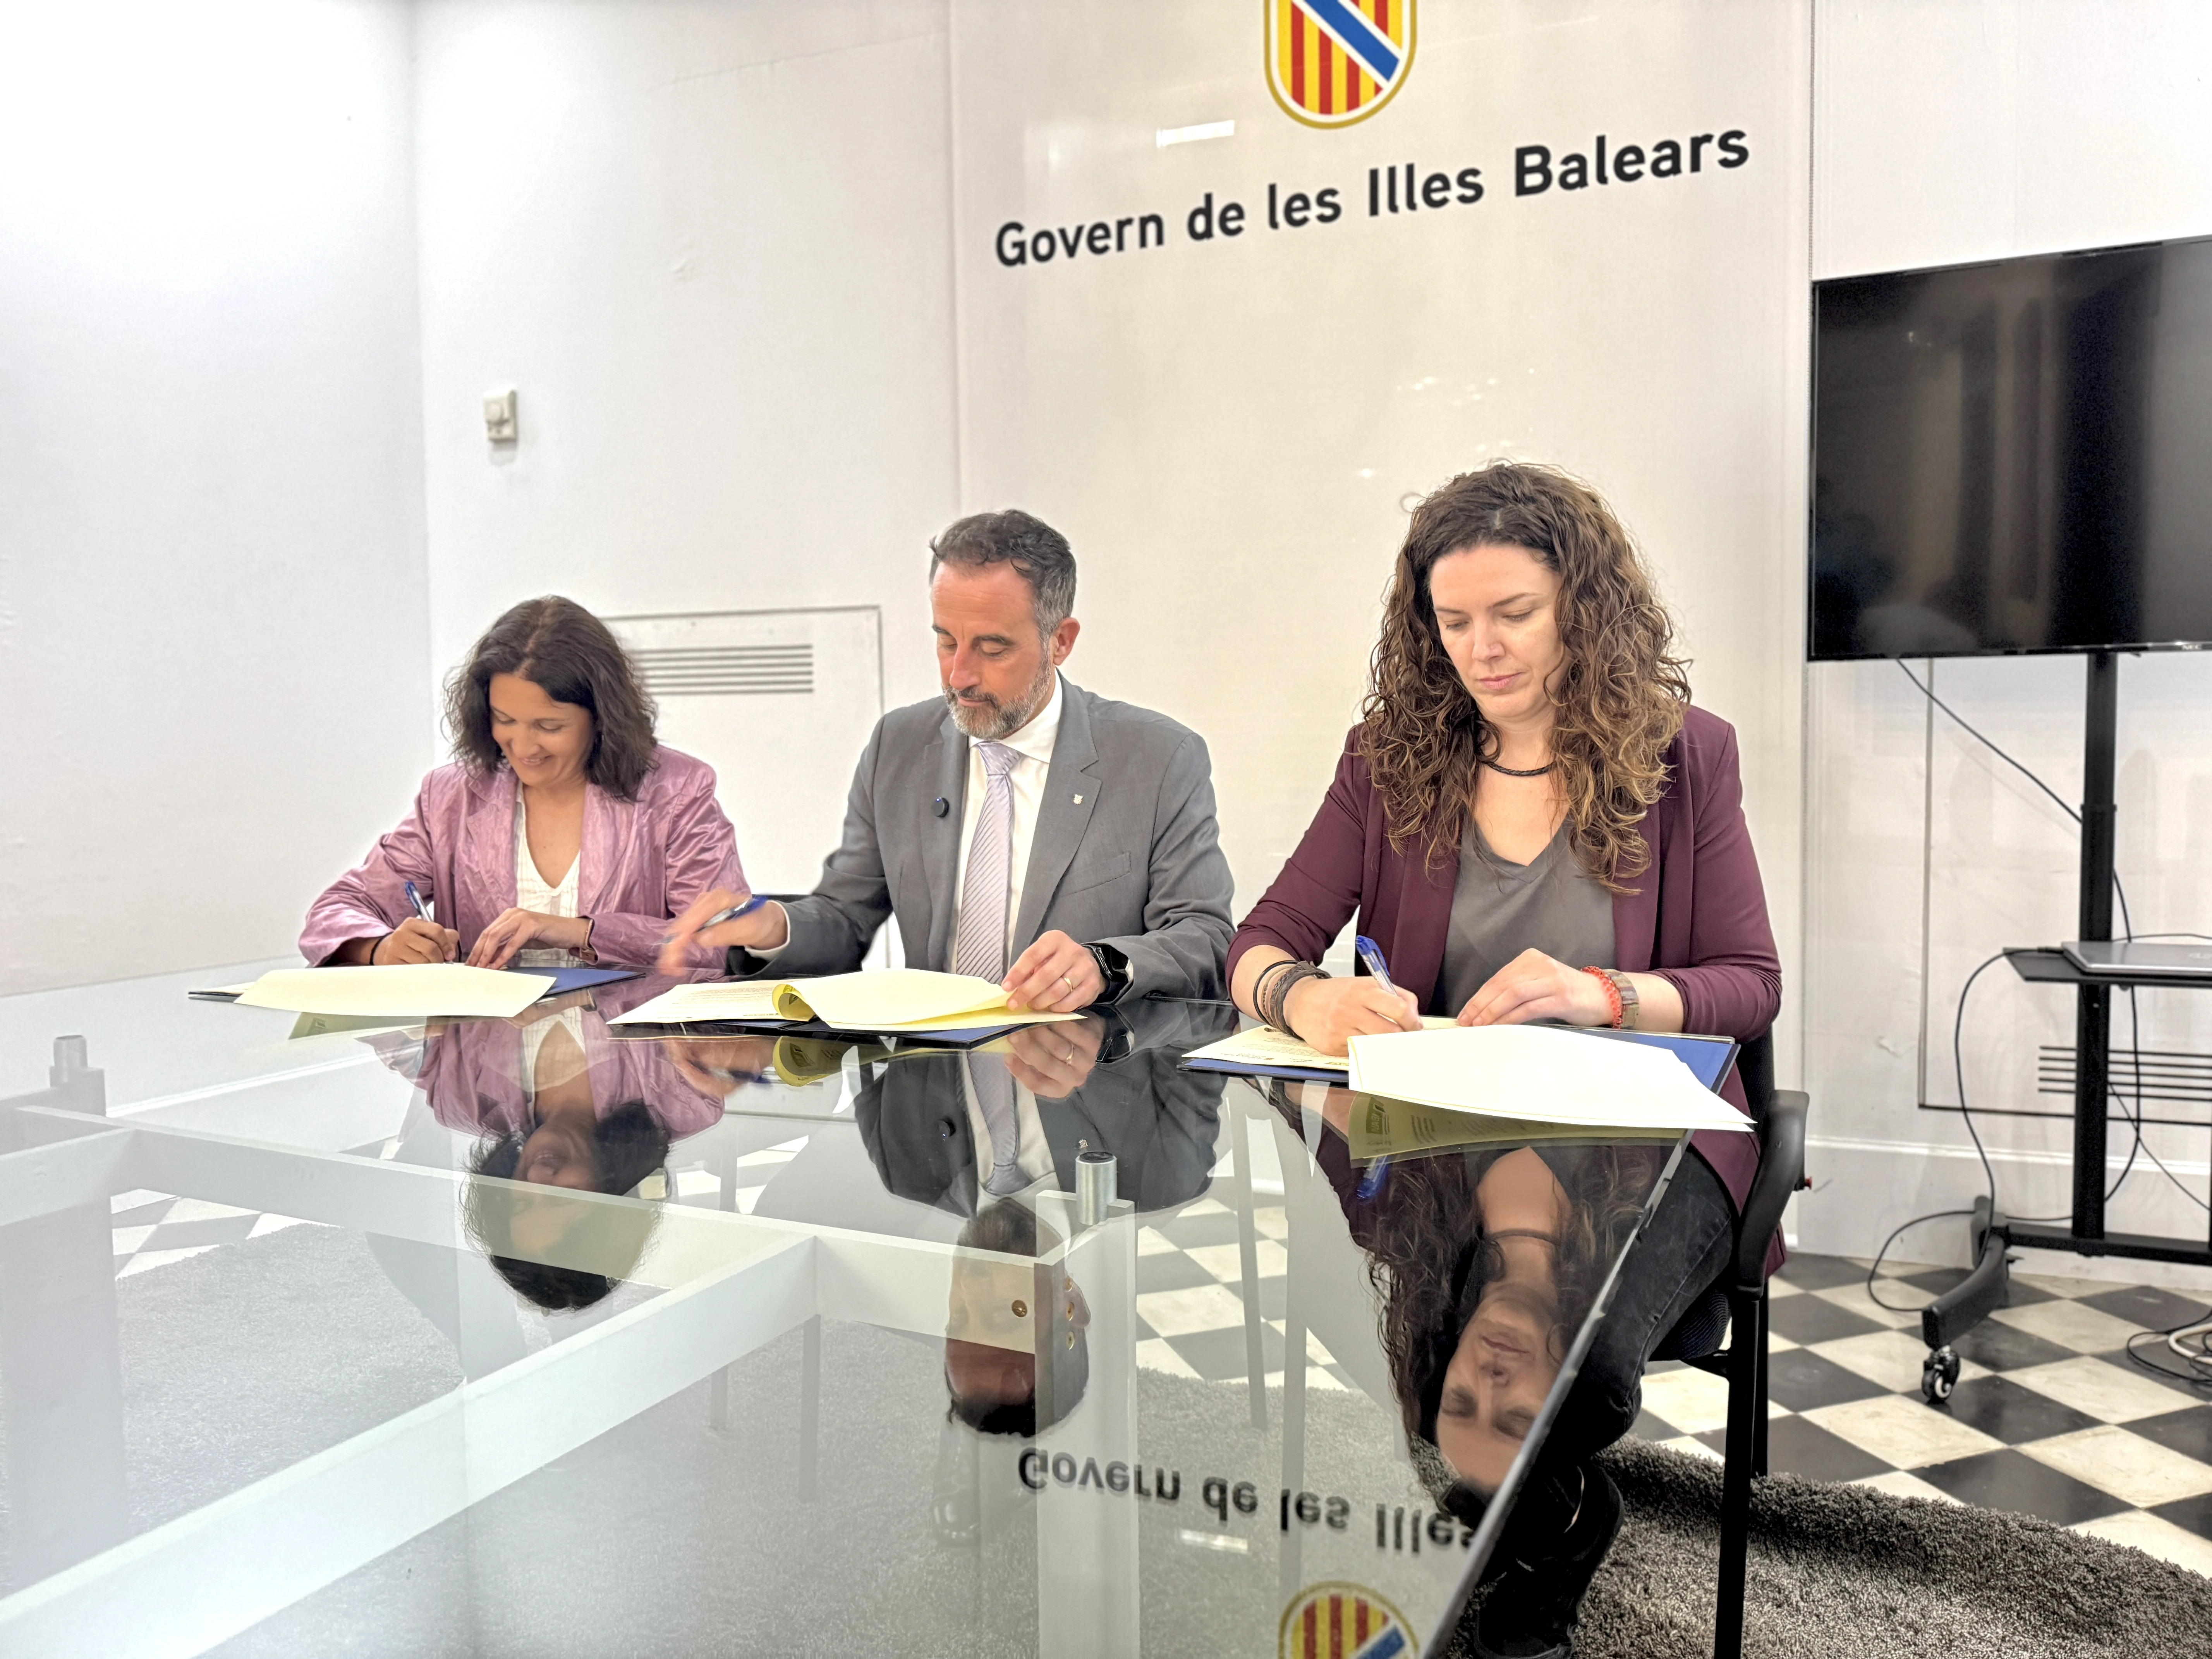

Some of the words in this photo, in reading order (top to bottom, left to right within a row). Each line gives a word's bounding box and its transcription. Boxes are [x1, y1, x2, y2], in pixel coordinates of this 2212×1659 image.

[996, 214, 1164, 267] Govern
[1187, 192, 1245, 241] de
[1268, 183, 1341, 230] les
[1369, 163, 1484, 217] Illes
[1515, 130, 1749, 197] Balears
